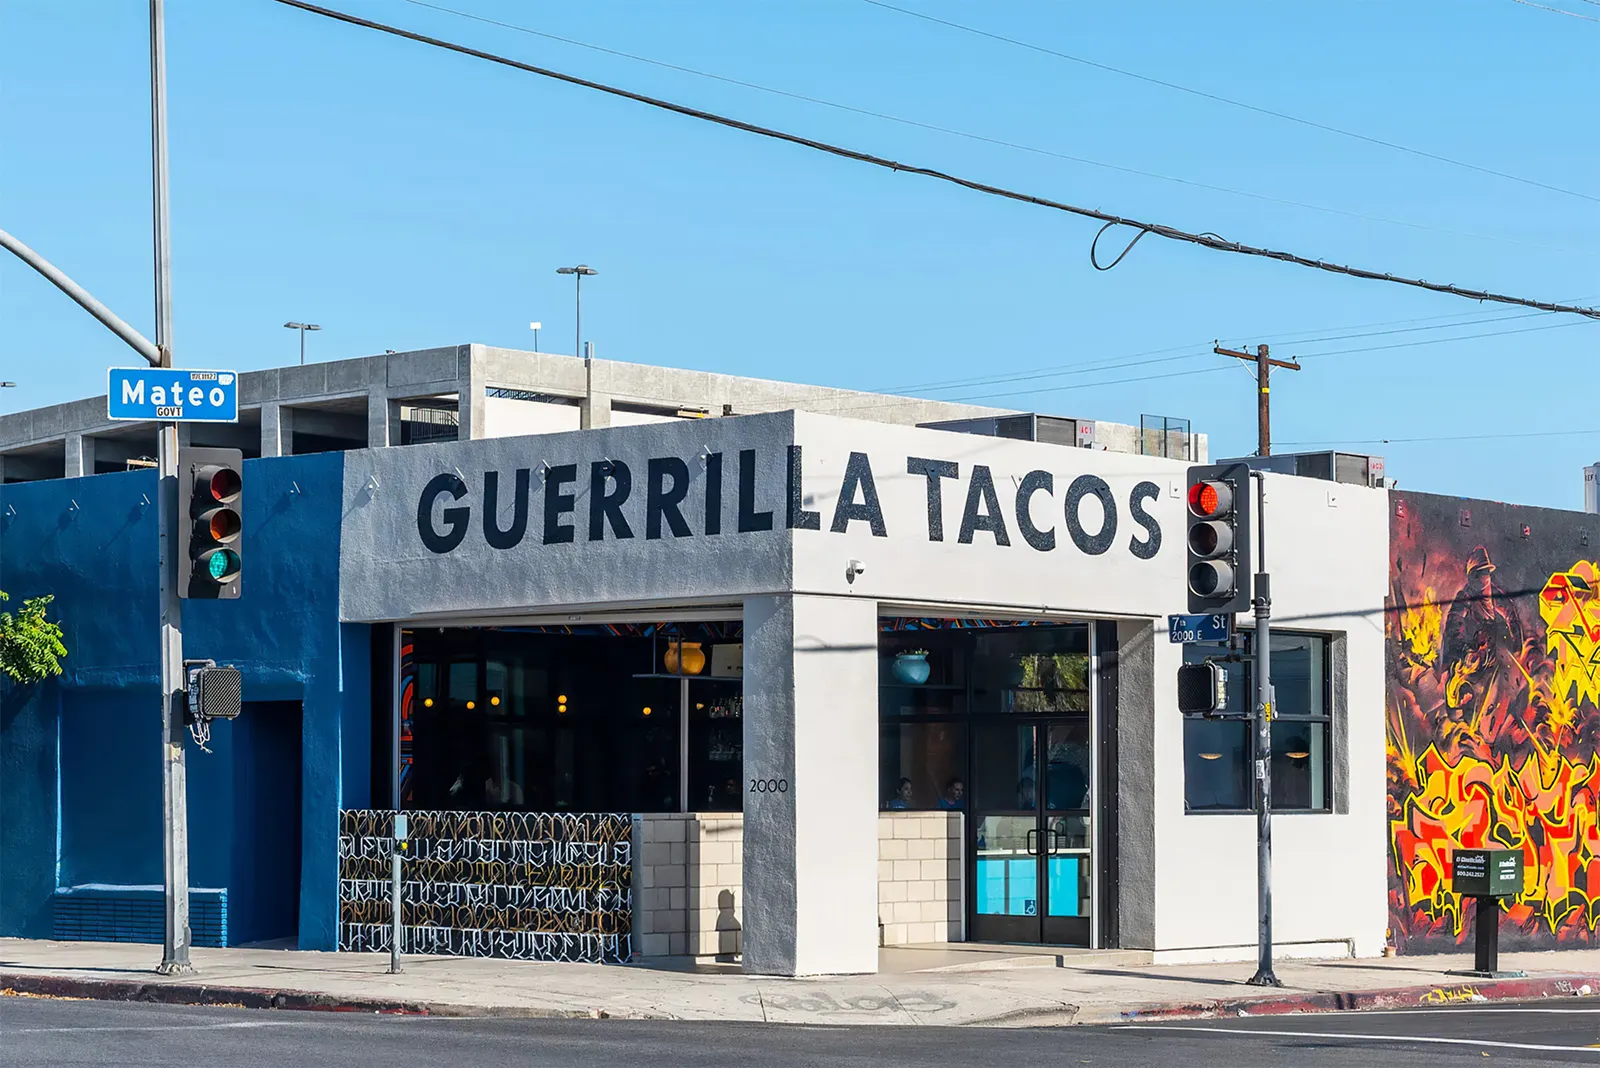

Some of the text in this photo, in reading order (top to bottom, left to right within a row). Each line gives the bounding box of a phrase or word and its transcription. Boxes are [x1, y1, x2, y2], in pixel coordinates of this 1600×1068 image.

[122, 379, 225, 407] Mateo
[157, 407, 181, 416] GOVT
[417, 445, 1162, 560] GUERRILLA TACOS
[1212, 615, 1225, 629] St
[1172, 630, 1202, 640] 2000 E
[750, 779, 788, 792] 2000
